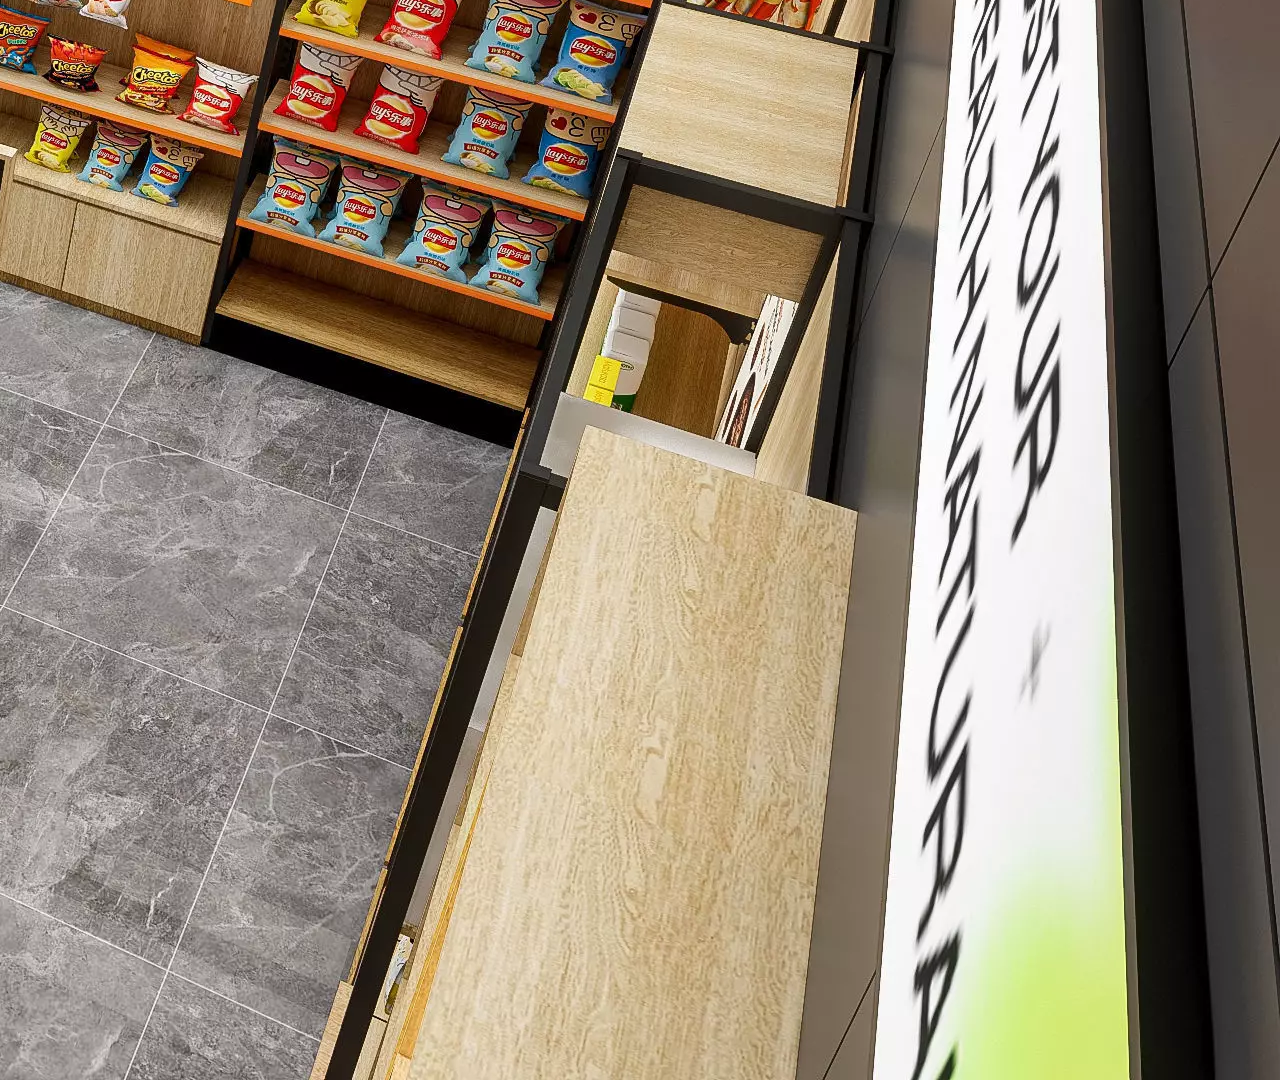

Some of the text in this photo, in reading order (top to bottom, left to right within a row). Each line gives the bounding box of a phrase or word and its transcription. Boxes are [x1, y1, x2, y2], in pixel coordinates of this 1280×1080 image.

[52, 59, 94, 75] Cheetos
[133, 67, 182, 86] Cheetos
[1010, 88, 1061, 550] YOUR
